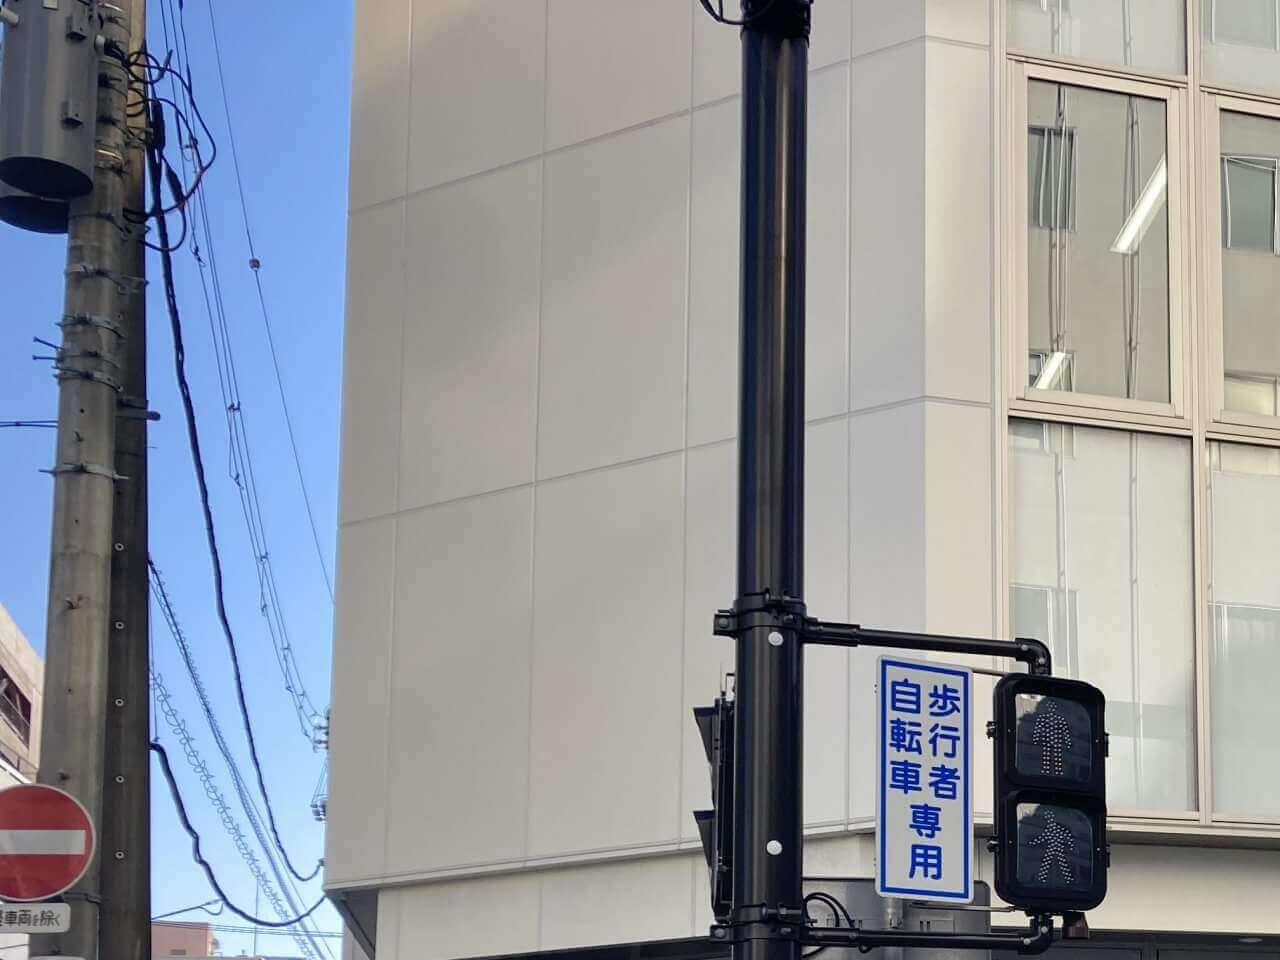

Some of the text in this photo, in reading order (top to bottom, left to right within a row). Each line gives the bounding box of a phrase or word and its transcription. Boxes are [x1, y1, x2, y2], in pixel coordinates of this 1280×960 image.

[889, 678, 923, 795] 自転車
[929, 684, 961, 801] 歩行者
[909, 803, 943, 881] 専用
[0, 909, 61, 928] 車両を除く
